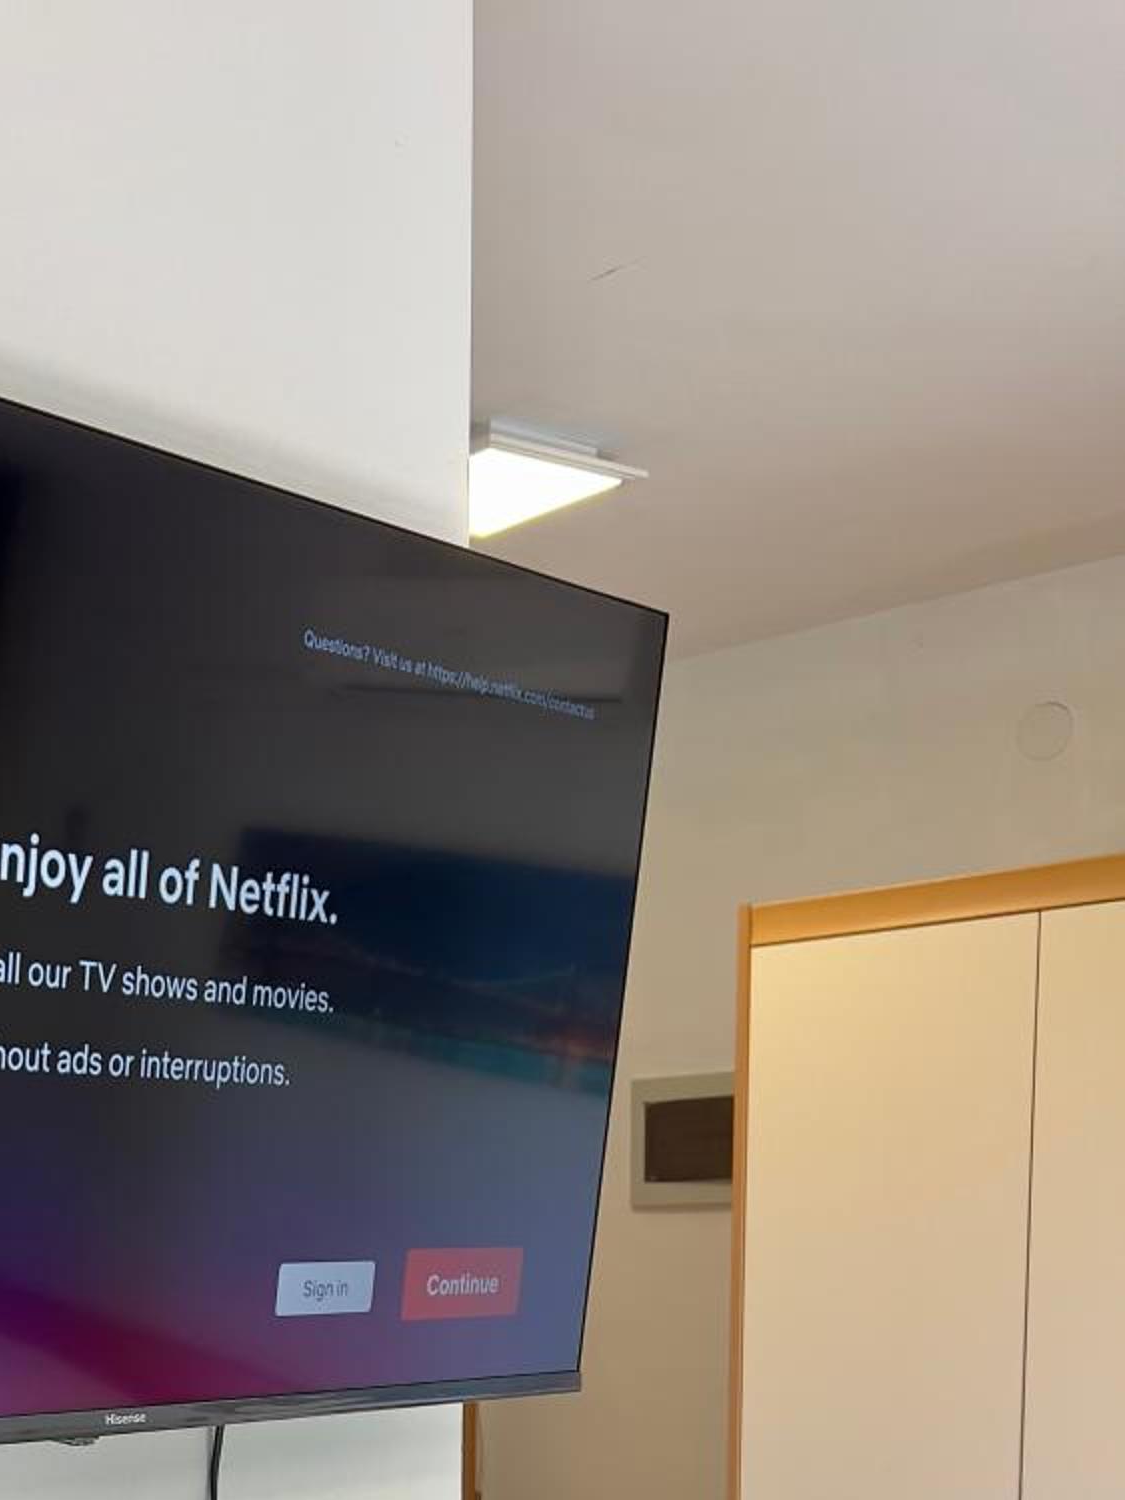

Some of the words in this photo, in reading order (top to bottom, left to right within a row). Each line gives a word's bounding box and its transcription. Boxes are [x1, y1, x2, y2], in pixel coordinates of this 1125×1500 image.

[304, 629, 370, 661] Questions?
[372, 648, 397, 669] Visit
[399, 658, 413, 673] us
[102, 849, 150, 899] all
[158, 858, 200, 905] of
[208, 863, 339, 925] Netflix.
[28, 960, 73, 990] our
[78, 960, 118, 994] TV
[121, 965, 198, 1002] shows
[204, 976, 248, 1006] and
[252, 984, 335, 1014] movies.
[56, 1043, 103, 1077] ads
[108, 1051, 136, 1078] or
[139, 1048, 291, 1090] interruptions.
[302, 1277, 335, 1301] Sign
[337, 1278, 349, 1297] in
[426, 1273, 500, 1298] Continue
[105, 1411, 147, 1426] Hisense
